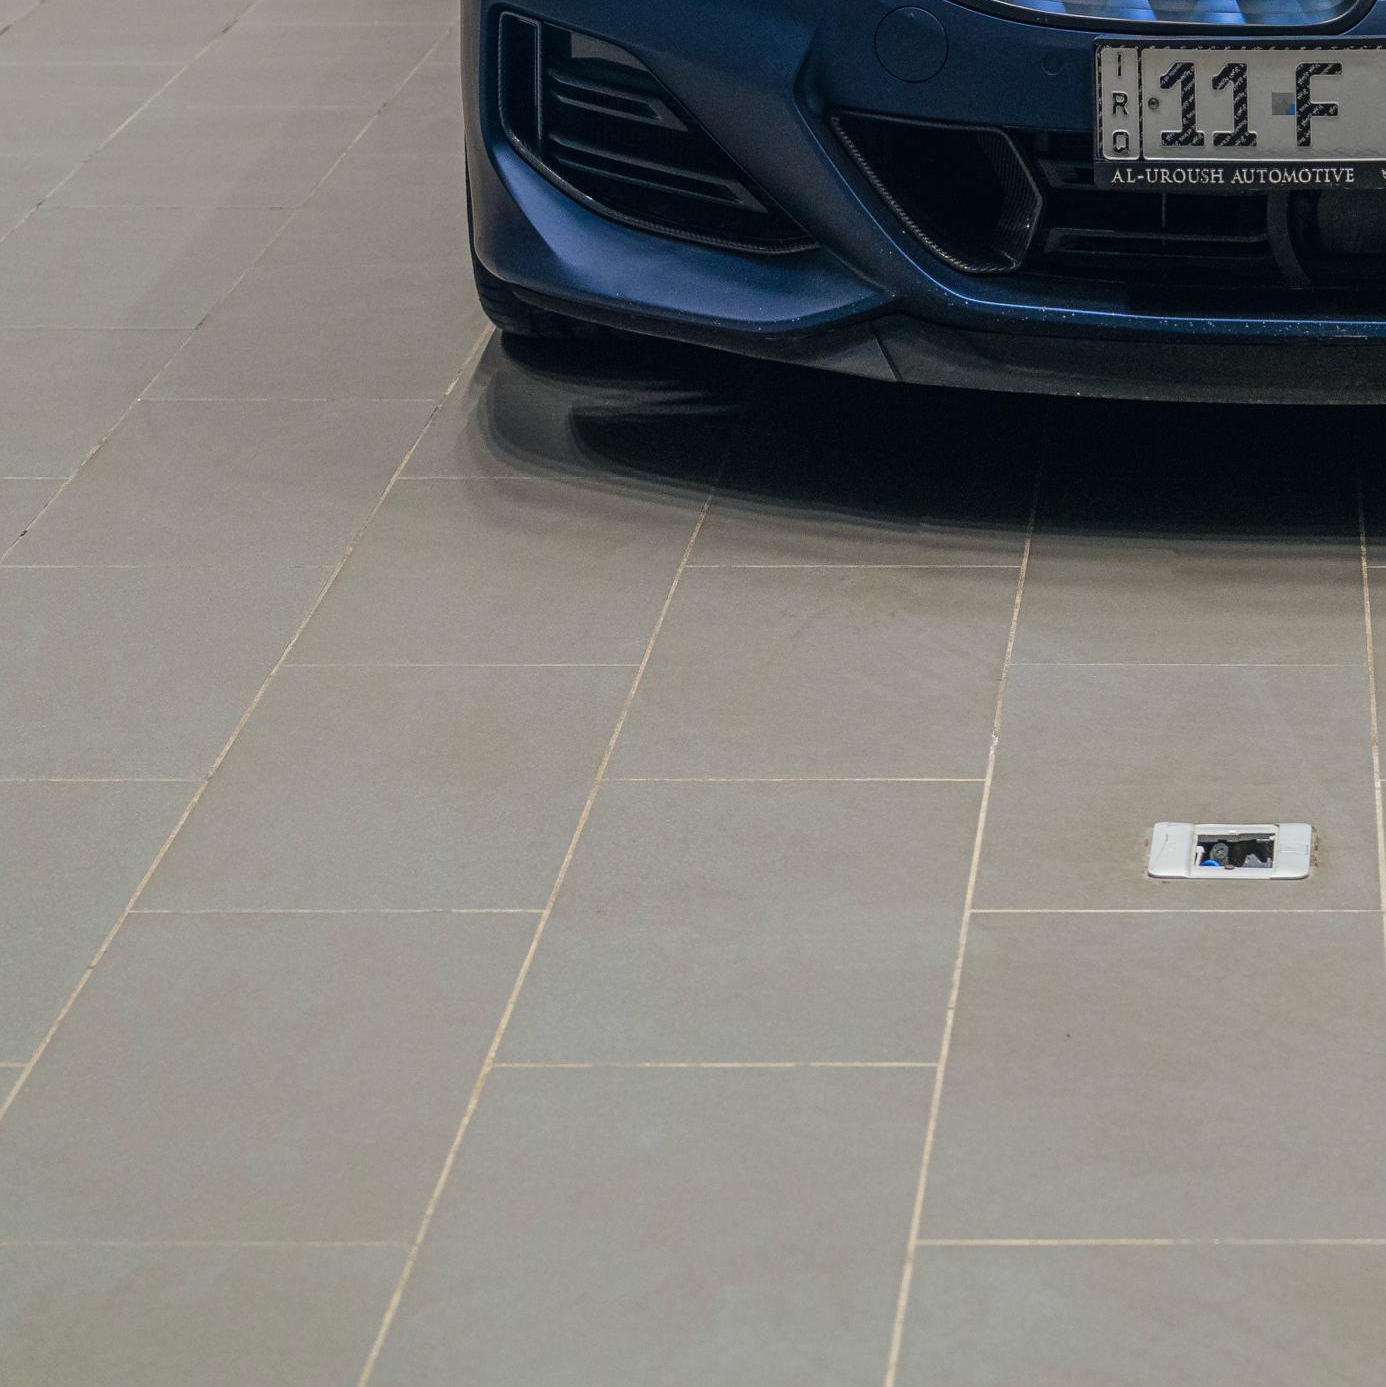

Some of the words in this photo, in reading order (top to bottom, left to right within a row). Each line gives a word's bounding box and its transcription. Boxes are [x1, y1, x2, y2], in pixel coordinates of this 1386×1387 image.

[1160, 62, 1257, 147] 11
[1296, 63, 1342, 147] F
[1111, 168, 1225, 184] AL-UROUSH
[1231, 167, 1355, 184] AUTOMOTIVE
